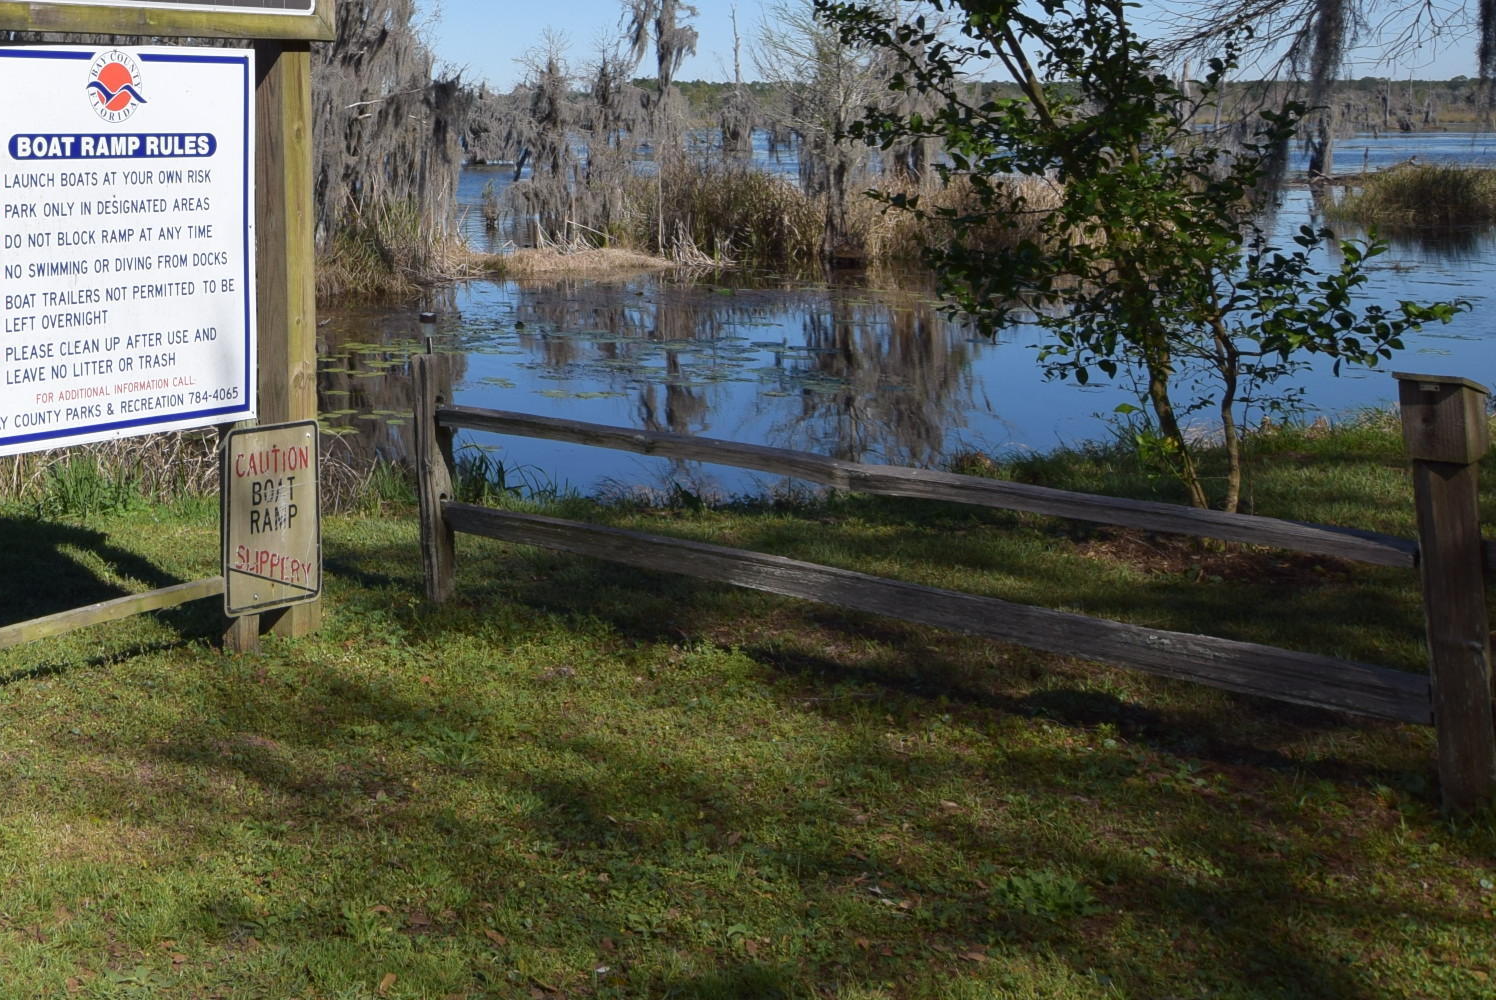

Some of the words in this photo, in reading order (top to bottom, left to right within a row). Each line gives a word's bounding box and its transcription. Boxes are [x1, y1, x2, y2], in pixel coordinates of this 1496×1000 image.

[91, 58, 107, 77] BAY
[110, 53, 141, 88] COUNTY
[90, 92, 137, 120] FLORIDA
[17, 137, 75, 157] BOAT
[81, 137, 140, 156] RAMP
[146, 136, 209, 155] RULES
[4, 173, 55, 188] LAUNCH
[60, 171, 98, 187] BOATS
[103, 172, 117, 185] AT
[122, 171, 153, 185] YOUR
[158, 170, 183, 184] OWN
[187, 169, 212, 183] RISK
[4, 203, 37, 218] PARK
[43, 202, 75, 217] ONLY
[80, 201, 92, 215] IN
[97, 198, 167, 215] DESIGNATED
[172, 197, 210, 212] AREAS
[4, 234, 22, 249] DO
[28, 232, 52, 248] NOT
[57, 230, 96, 246] BLOCK
[101, 229, 135, 244] RAMP
[139, 228, 153, 241] AT
[158, 226, 182, 240] ANY
[188, 225, 213, 239] TIME
[4, 264, 22, 279] NO
[28, 260, 88, 278] SWIMMING
[94, 259, 110, 273] OR
[115, 256, 152, 272] DIVING
[157, 254, 188, 269] FROM
[193, 252, 228, 267] DOCKS
[5, 293, 36, 310] BOAT
[42, 289, 101, 307] TRAILERS
[105, 286, 128, 302] NOT
[132, 282, 195, 299] PERMITTED
[203, 280, 217, 293] TO
[221, 278, 235, 292] BE
[5, 316, 36, 333] LEFT
[41, 310, 108, 330] OVERNIGHT
[5, 343, 54, 362] PLEASE
[60, 338, 100, 356] CLEAN
[105, 336, 121, 351] UP
[126, 332, 162, 349] AFTER
[167, 330, 189, 345] USE
[194, 327, 217, 342] AND
[6, 367, 45, 385] LEAVE
[51, 364, 67, 380] NO
[73, 359, 113, 377] LITTER
[118, 357, 133, 372] OR
[138, 352, 176, 370] TRASH
[36, 391, 54, 404] FOR
[58, 383, 110, 401] ADDITIONAL
[114, 378, 169, 396] INFORMATION
[14, 409, 61, 428] COUNTY
[66, 404, 102, 421] PARKS
[107, 402, 115, 415] &
[120, 393, 184, 414] RECREATION
[188, 386, 239, 404] 784-4065
[235, 446, 309, 478] CAUTION
[252, 476, 295, 505] BOAT
[250, 504, 297, 534] RAMP
[235, 545, 312, 583] SLIPPERY
